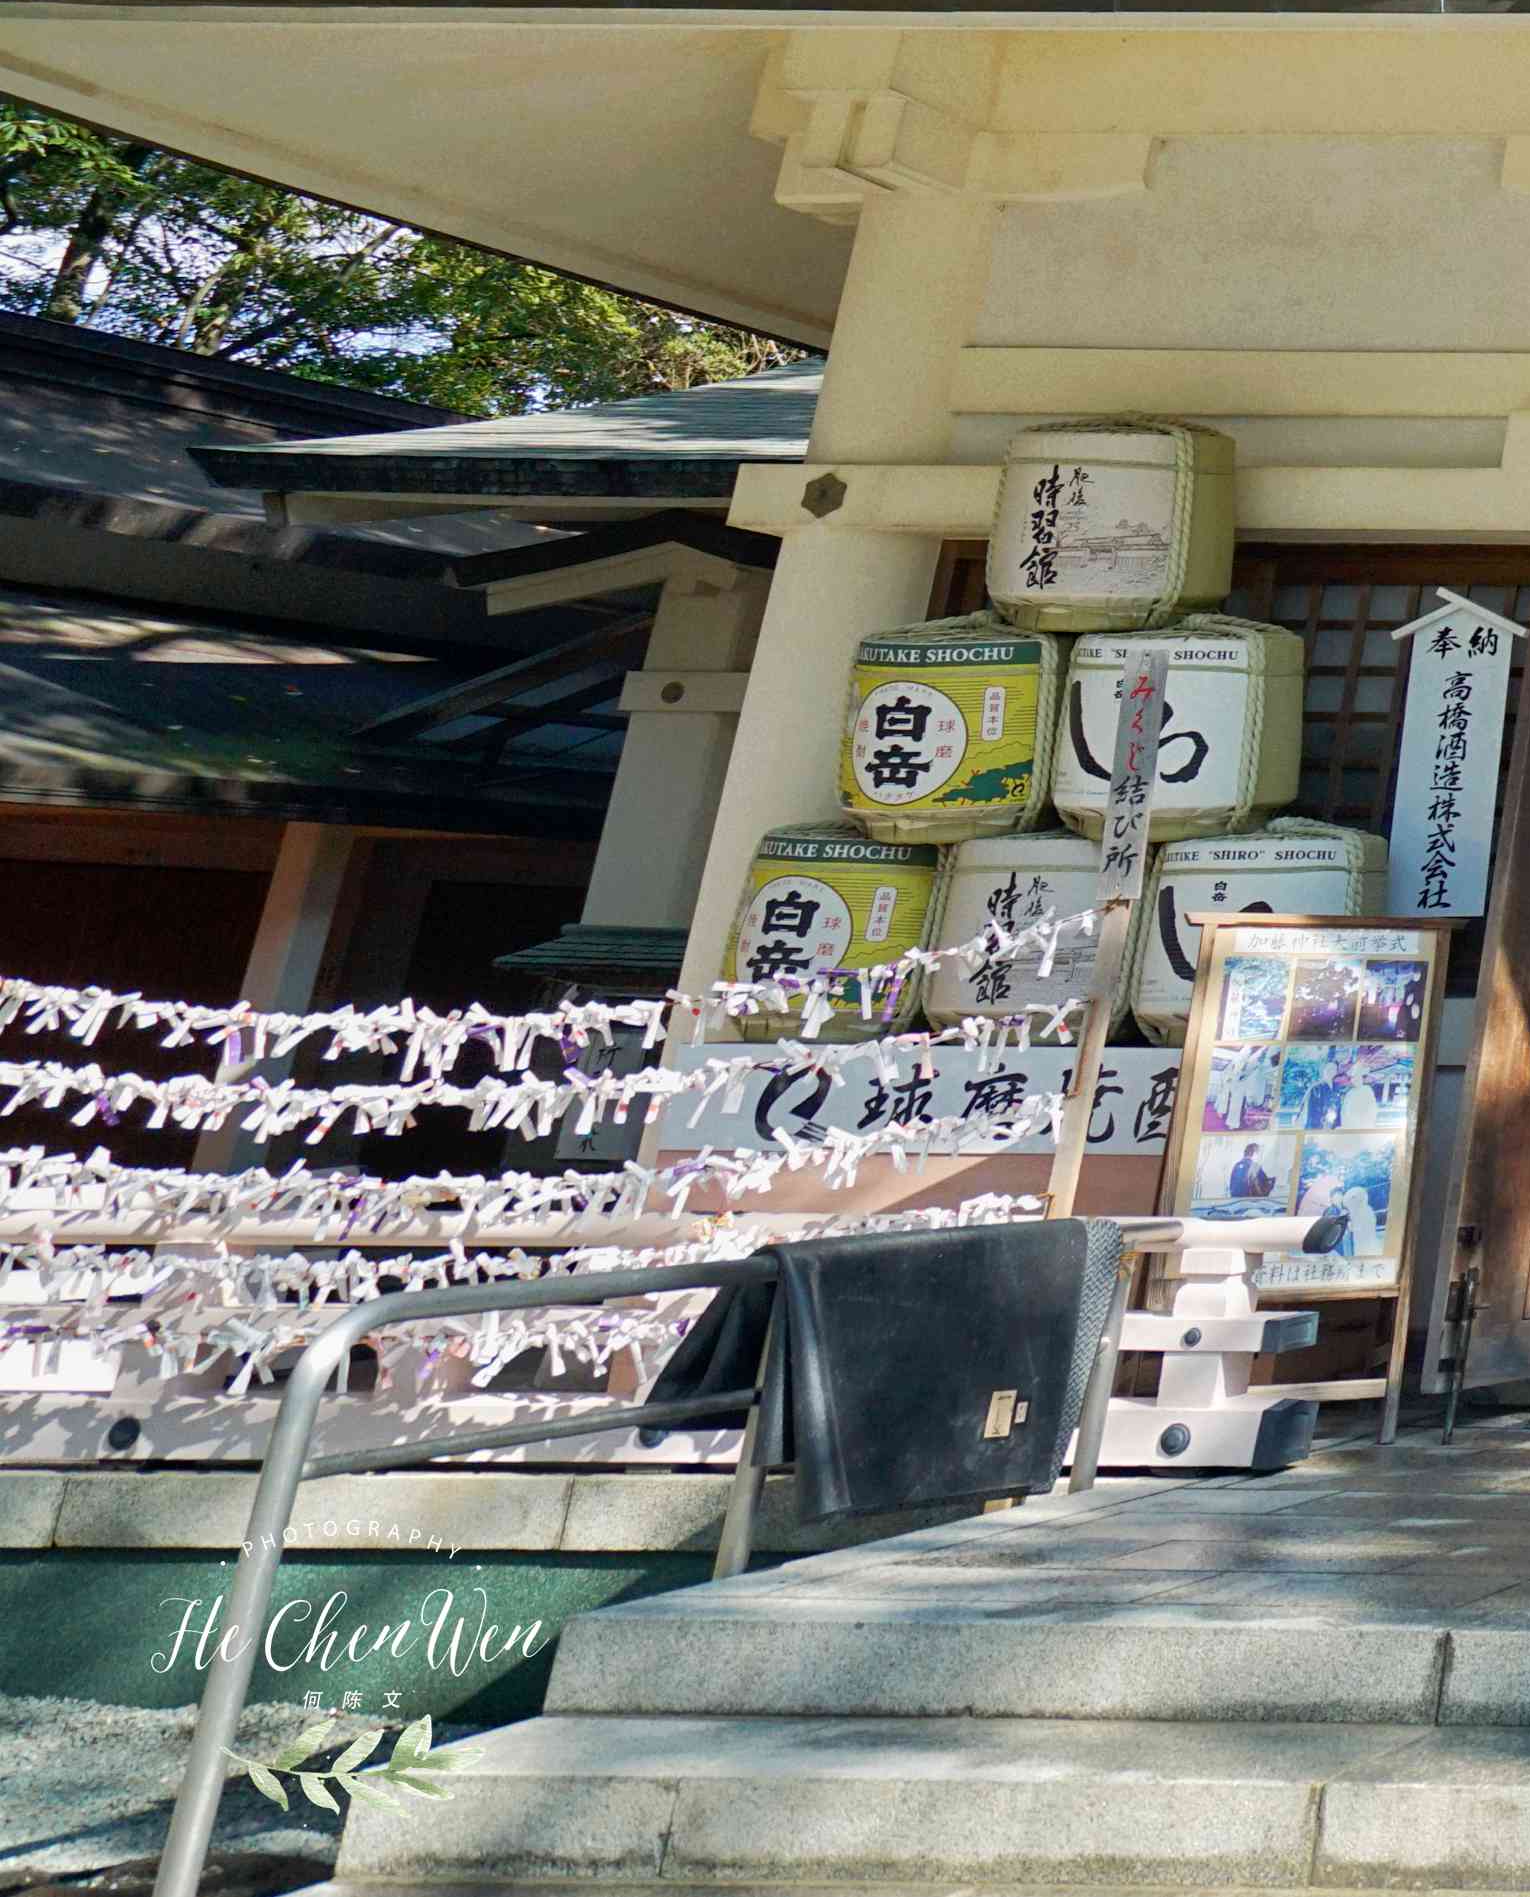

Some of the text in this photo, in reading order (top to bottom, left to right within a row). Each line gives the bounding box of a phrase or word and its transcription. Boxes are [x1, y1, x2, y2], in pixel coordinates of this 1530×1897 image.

[925, 647, 1015, 663] SHOCHU
[1174, 649, 1239, 660] SHOCHU
[1427, 626, 1498, 659] 奉納
[865, 695, 933, 789] 白岳
[1102, 675, 1156, 878] みくじ結び所
[1417, 671, 1473, 910] 高橋酒造株式会社
[823, 844, 912, 861] SHOCHU
[1208, 849, 1266, 861] "SHIRO"
[1274, 850, 1337, 861] SHOCHU
